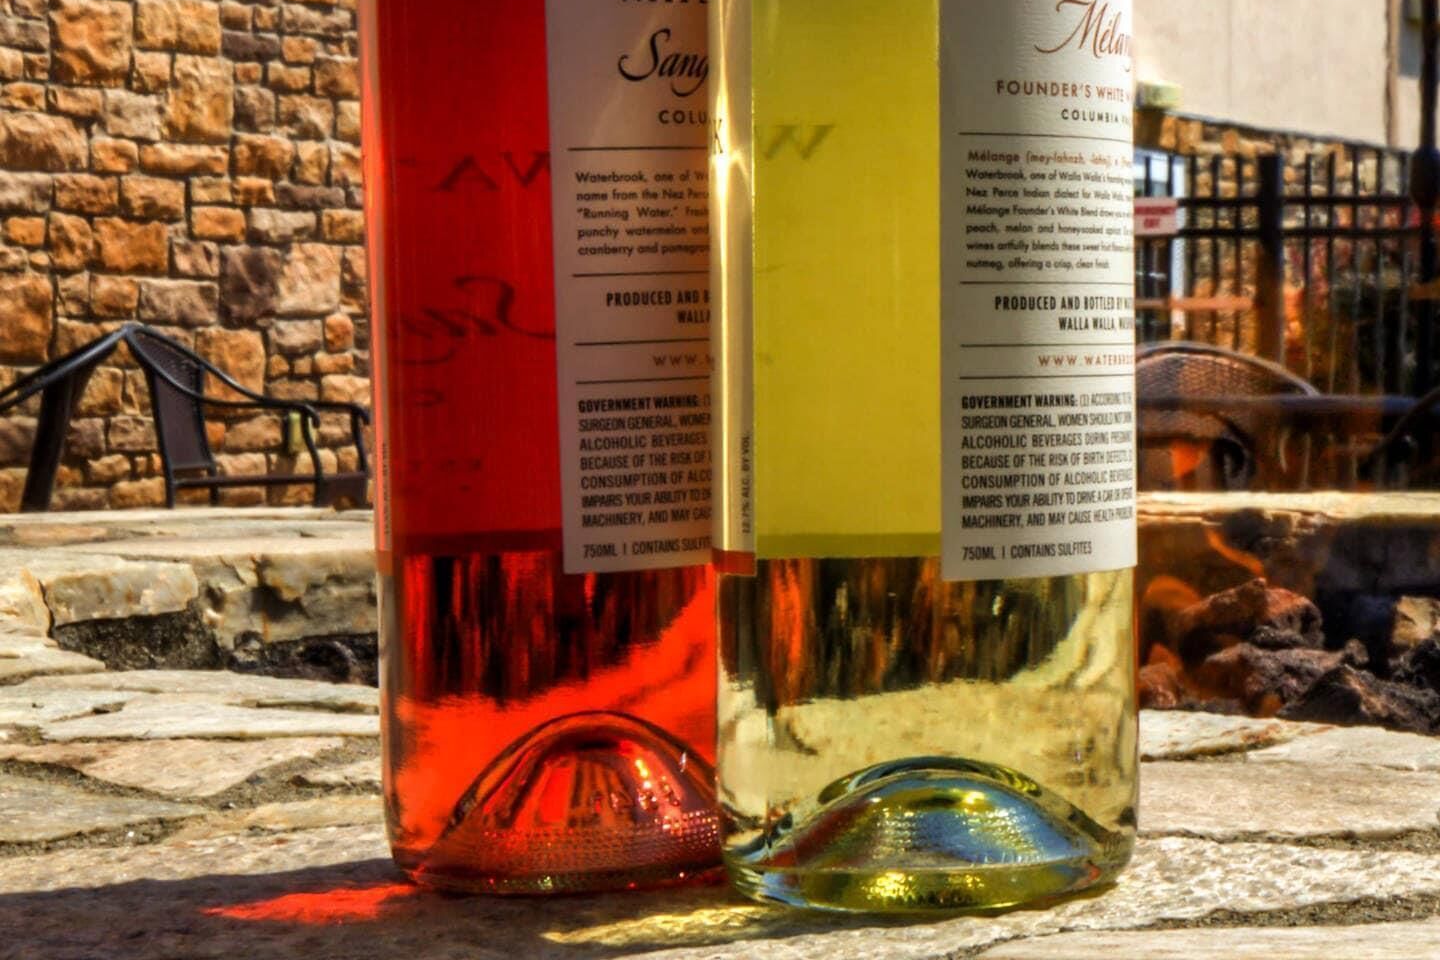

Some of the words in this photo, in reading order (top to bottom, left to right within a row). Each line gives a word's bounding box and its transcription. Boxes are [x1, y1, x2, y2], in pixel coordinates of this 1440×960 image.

[996, 80, 1092, 98] FOUNDER'S
[1061, 109, 1119, 123] COLUMBIA
[576, 171, 647, 183] Waterbrook,
[655, 173, 674, 182] one
[680, 170, 689, 181] of
[1030, 171, 1046, 180] one
[1048, 170, 1057, 181] of
[577, 191, 607, 201] name
[612, 188, 638, 200] from
[642, 188, 658, 200] the
[663, 188, 684, 200] Nez
[966, 188, 988, 197] Nez
[1023, 188, 1049, 198] Indian
[578, 226, 619, 240] punchy
[626, 224, 686, 236] watermelon
[966, 222, 1000, 234] peach,
[1005, 223, 1032, 233] melon
[1037, 223, 1054, 233] and
[578, 243, 633, 257] cranberry
[637, 242, 658, 254] and
[966, 242, 994, 251] wines
[1032, 241, 1059, 251] blends
[1008, 258, 1043, 271] offering
[606, 290, 672, 307] PRODUCED
[677, 290, 700, 304] AND
[995, 296, 1056, 311] PRODUCED
[1061, 296, 1080, 310] AND
[1084, 296, 1114, 311] BOTTLED
[1059, 317, 1089, 332] WALLA
[579, 399, 650, 413] GOVERNMENT
[962, 395, 1032, 409] GOVERNMENT
[1035, 394, 1078, 407] WARNING:
[579, 418, 626, 432] SURGEON
[962, 415, 1008, 429] SURGEON
[1058, 413, 1088, 427] WOMEN
[580, 436, 646, 451] ALCOHOLIC
[962, 434, 1027, 450] ALCOHOLIC
[1032, 433, 1082, 447] BEVERAGES
[581, 456, 629, 470] BECAUSE
[632, 454, 645, 467] OF
[649, 453, 668, 465] THE
[671, 452, 691, 465] RISK
[962, 455, 1010, 469] BECAUSE
[1013, 454, 1026, 467] OF
[1029, 453, 1045, 467] THE
[1049, 452, 1068, 466] RISK
[1071, 452, 1081, 465] OF
[1084, 451, 1104, 465] BIRTH
[581, 474, 667, 489] CONSUMPTION
[671, 471, 683, 484] OF
[962, 473, 1045, 489] CONSUMPTION
[1049, 473, 1060, 486] OF
[1064, 470, 1107, 485] ALCOHOLIC
[582, 493, 623, 508] IMPAIRS
[625, 492, 655, 506] YOUR
[654, 490, 687, 503] ABILITY
[962, 493, 1003, 509] IMPAIRS
[1006, 492, 1031, 508] YOUR
[1033, 492, 1063, 506] ABILITY
[1066, 491, 1075, 505] TO
[1076, 490, 1097, 504] DRIVE
[648, 511, 668, 523] AND
[672, 509, 690, 521] MAY
[962, 513, 1024, 529] MACHINERY,
[1026, 513, 1046, 527] AND
[1049, 512, 1065, 526] MAY
[1068, 510, 1092, 524] CAUSE
[584, 544, 618, 558] 750ML
[632, 540, 681, 554] CONTAINS
[963, 546, 996, 560] 750ML
[1011, 543, 1056, 558] CONTAINS
[1058, 541, 1092, 556] SULFITES
